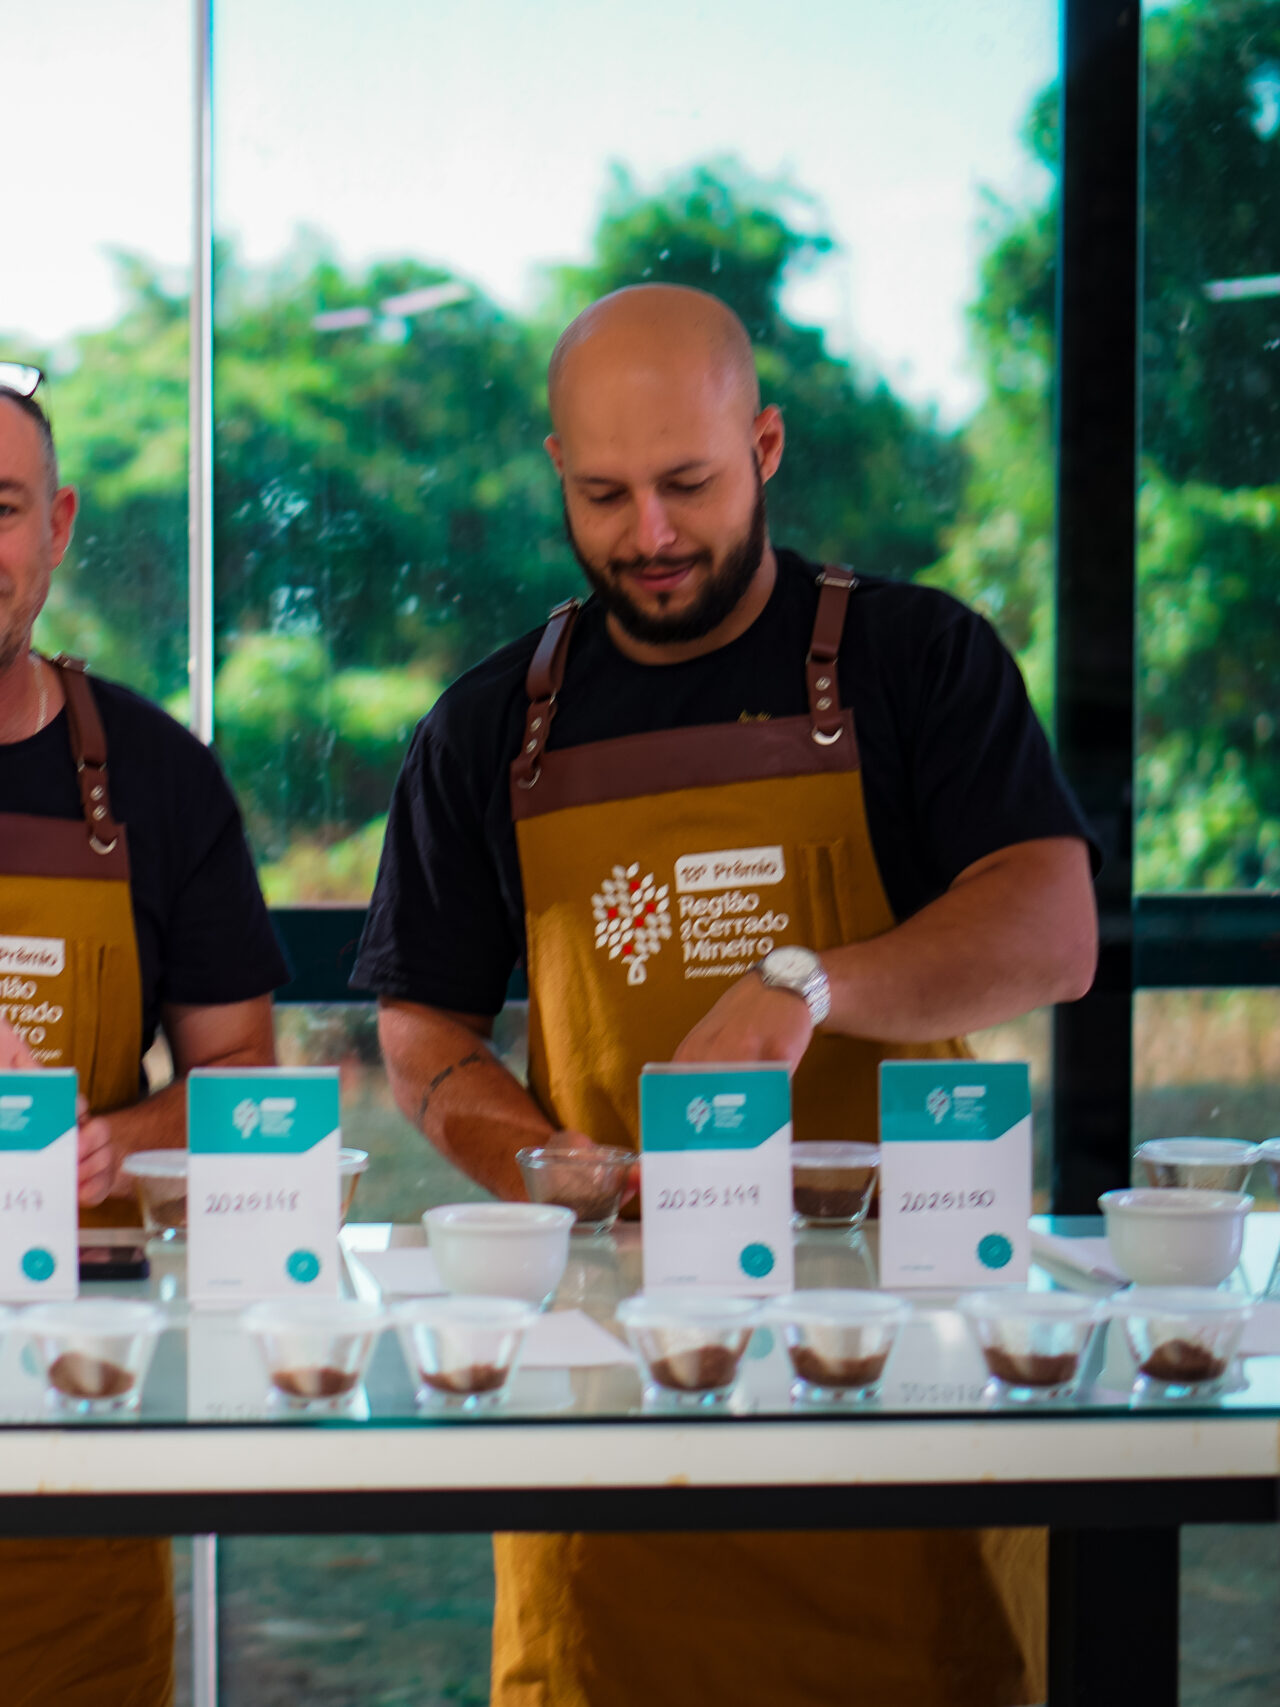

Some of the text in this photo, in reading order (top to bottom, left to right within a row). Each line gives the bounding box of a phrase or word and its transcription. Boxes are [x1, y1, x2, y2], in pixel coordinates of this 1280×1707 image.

[713, 858, 778, 880] Prêmio
[677, 890, 760, 919] Região
[692, 910, 790, 939] Cerrado
[682, 935, 775, 963] Mineiro
